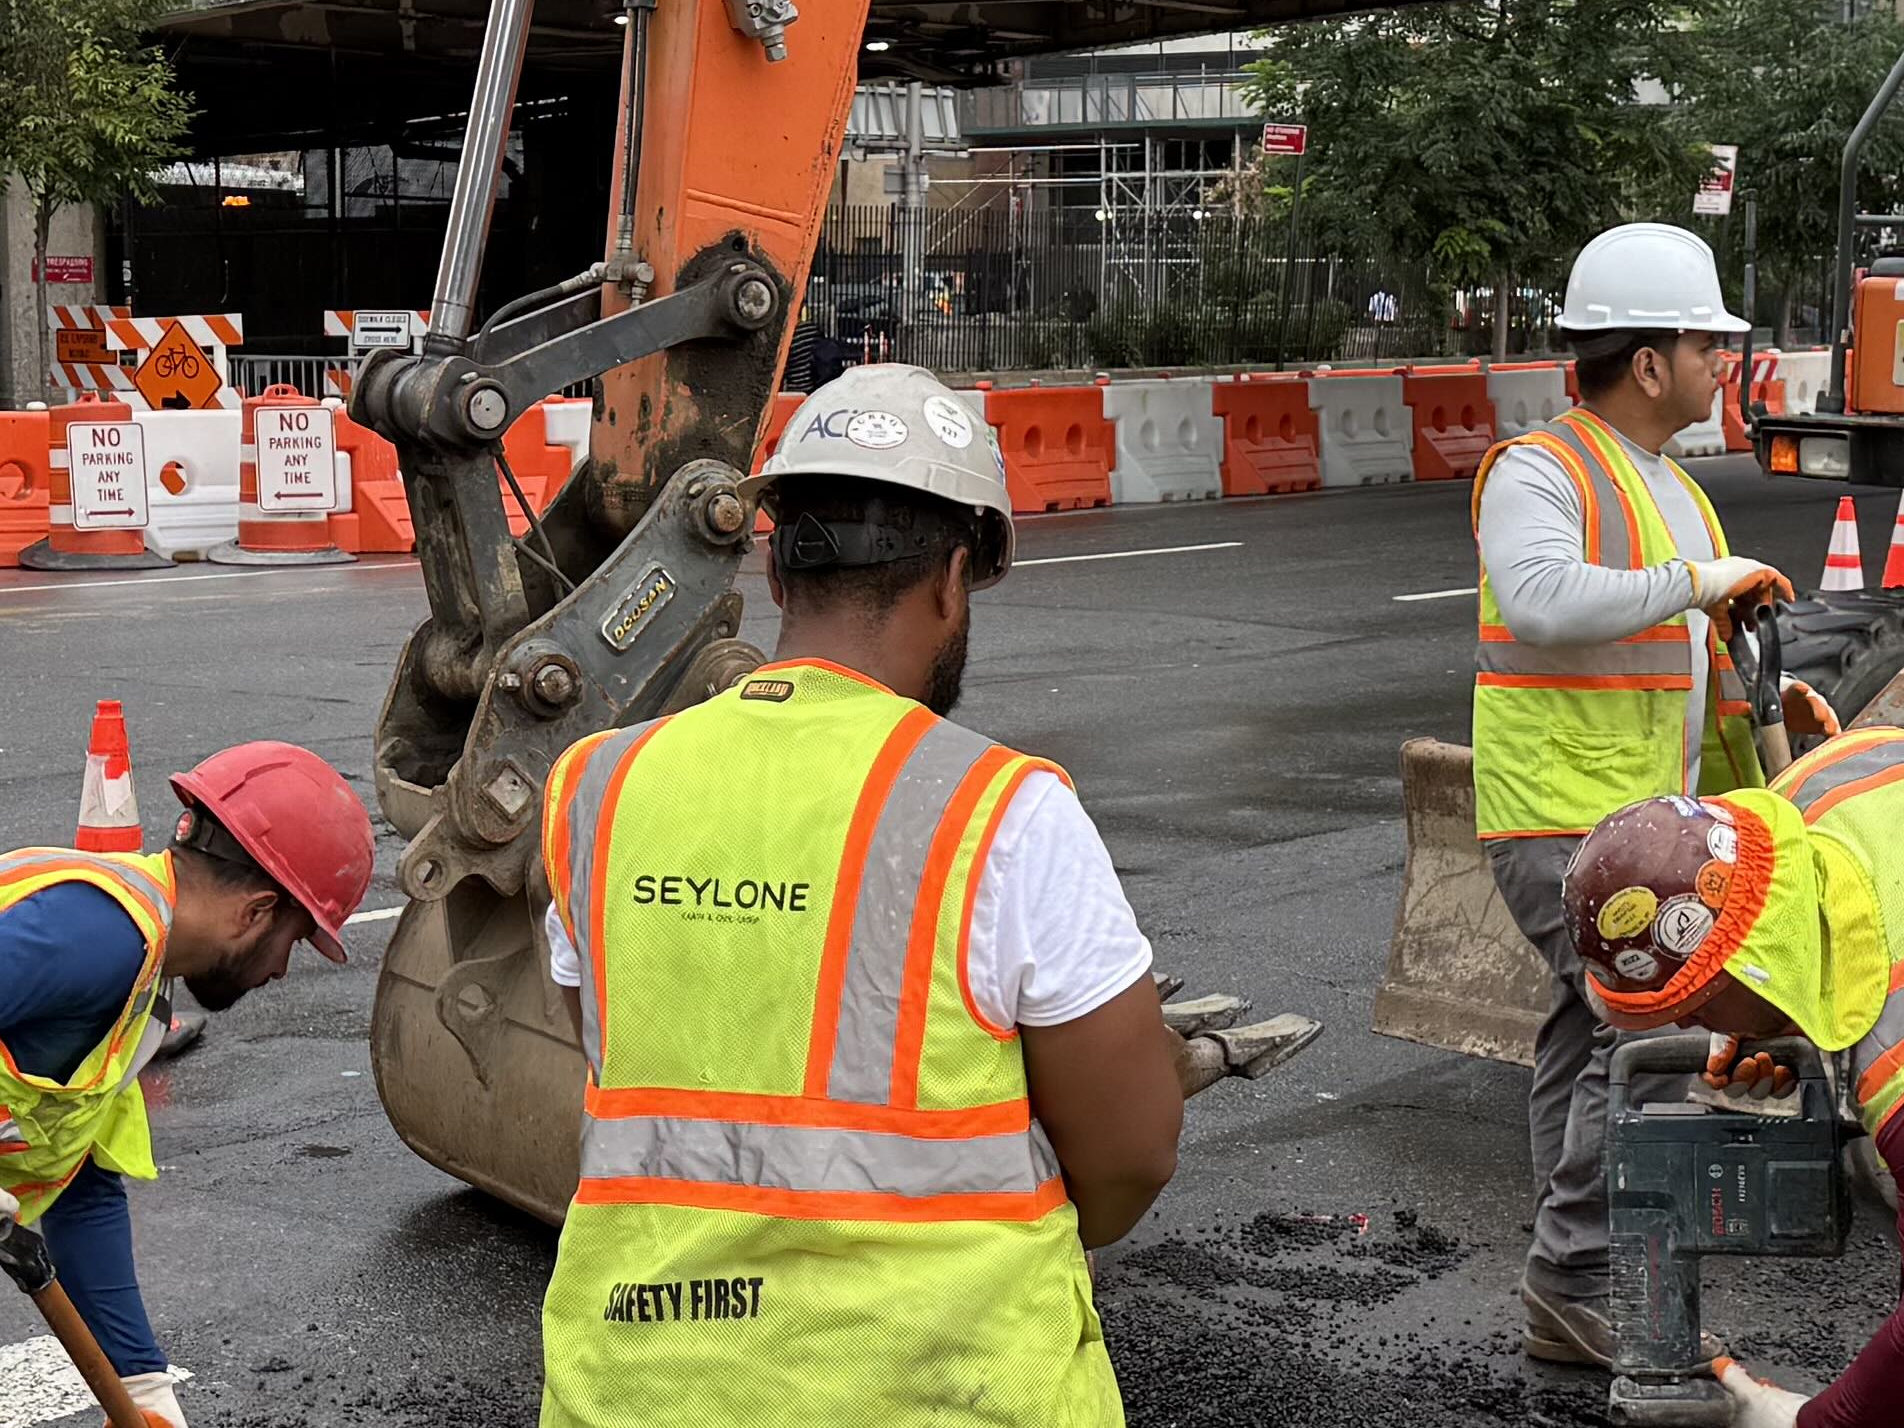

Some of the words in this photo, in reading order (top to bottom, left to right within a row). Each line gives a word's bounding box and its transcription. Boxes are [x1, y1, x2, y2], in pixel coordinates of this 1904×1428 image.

[279, 412, 309, 432] NO
[91, 427, 121, 448] NO
[268, 436, 322, 450] PARKING
[81, 451, 134, 466] PARKING
[284, 453, 309, 467] ANY
[97, 471, 120, 484] ANY
[283, 471, 312, 485] TIME
[97, 488, 124, 502] TIME
[613, 576, 669, 641] DOOSAN
[633, 874, 810, 912] SEYLONE
[603, 1281, 682, 1322] SAFETY
[689, 1276, 764, 1321] FIRST
